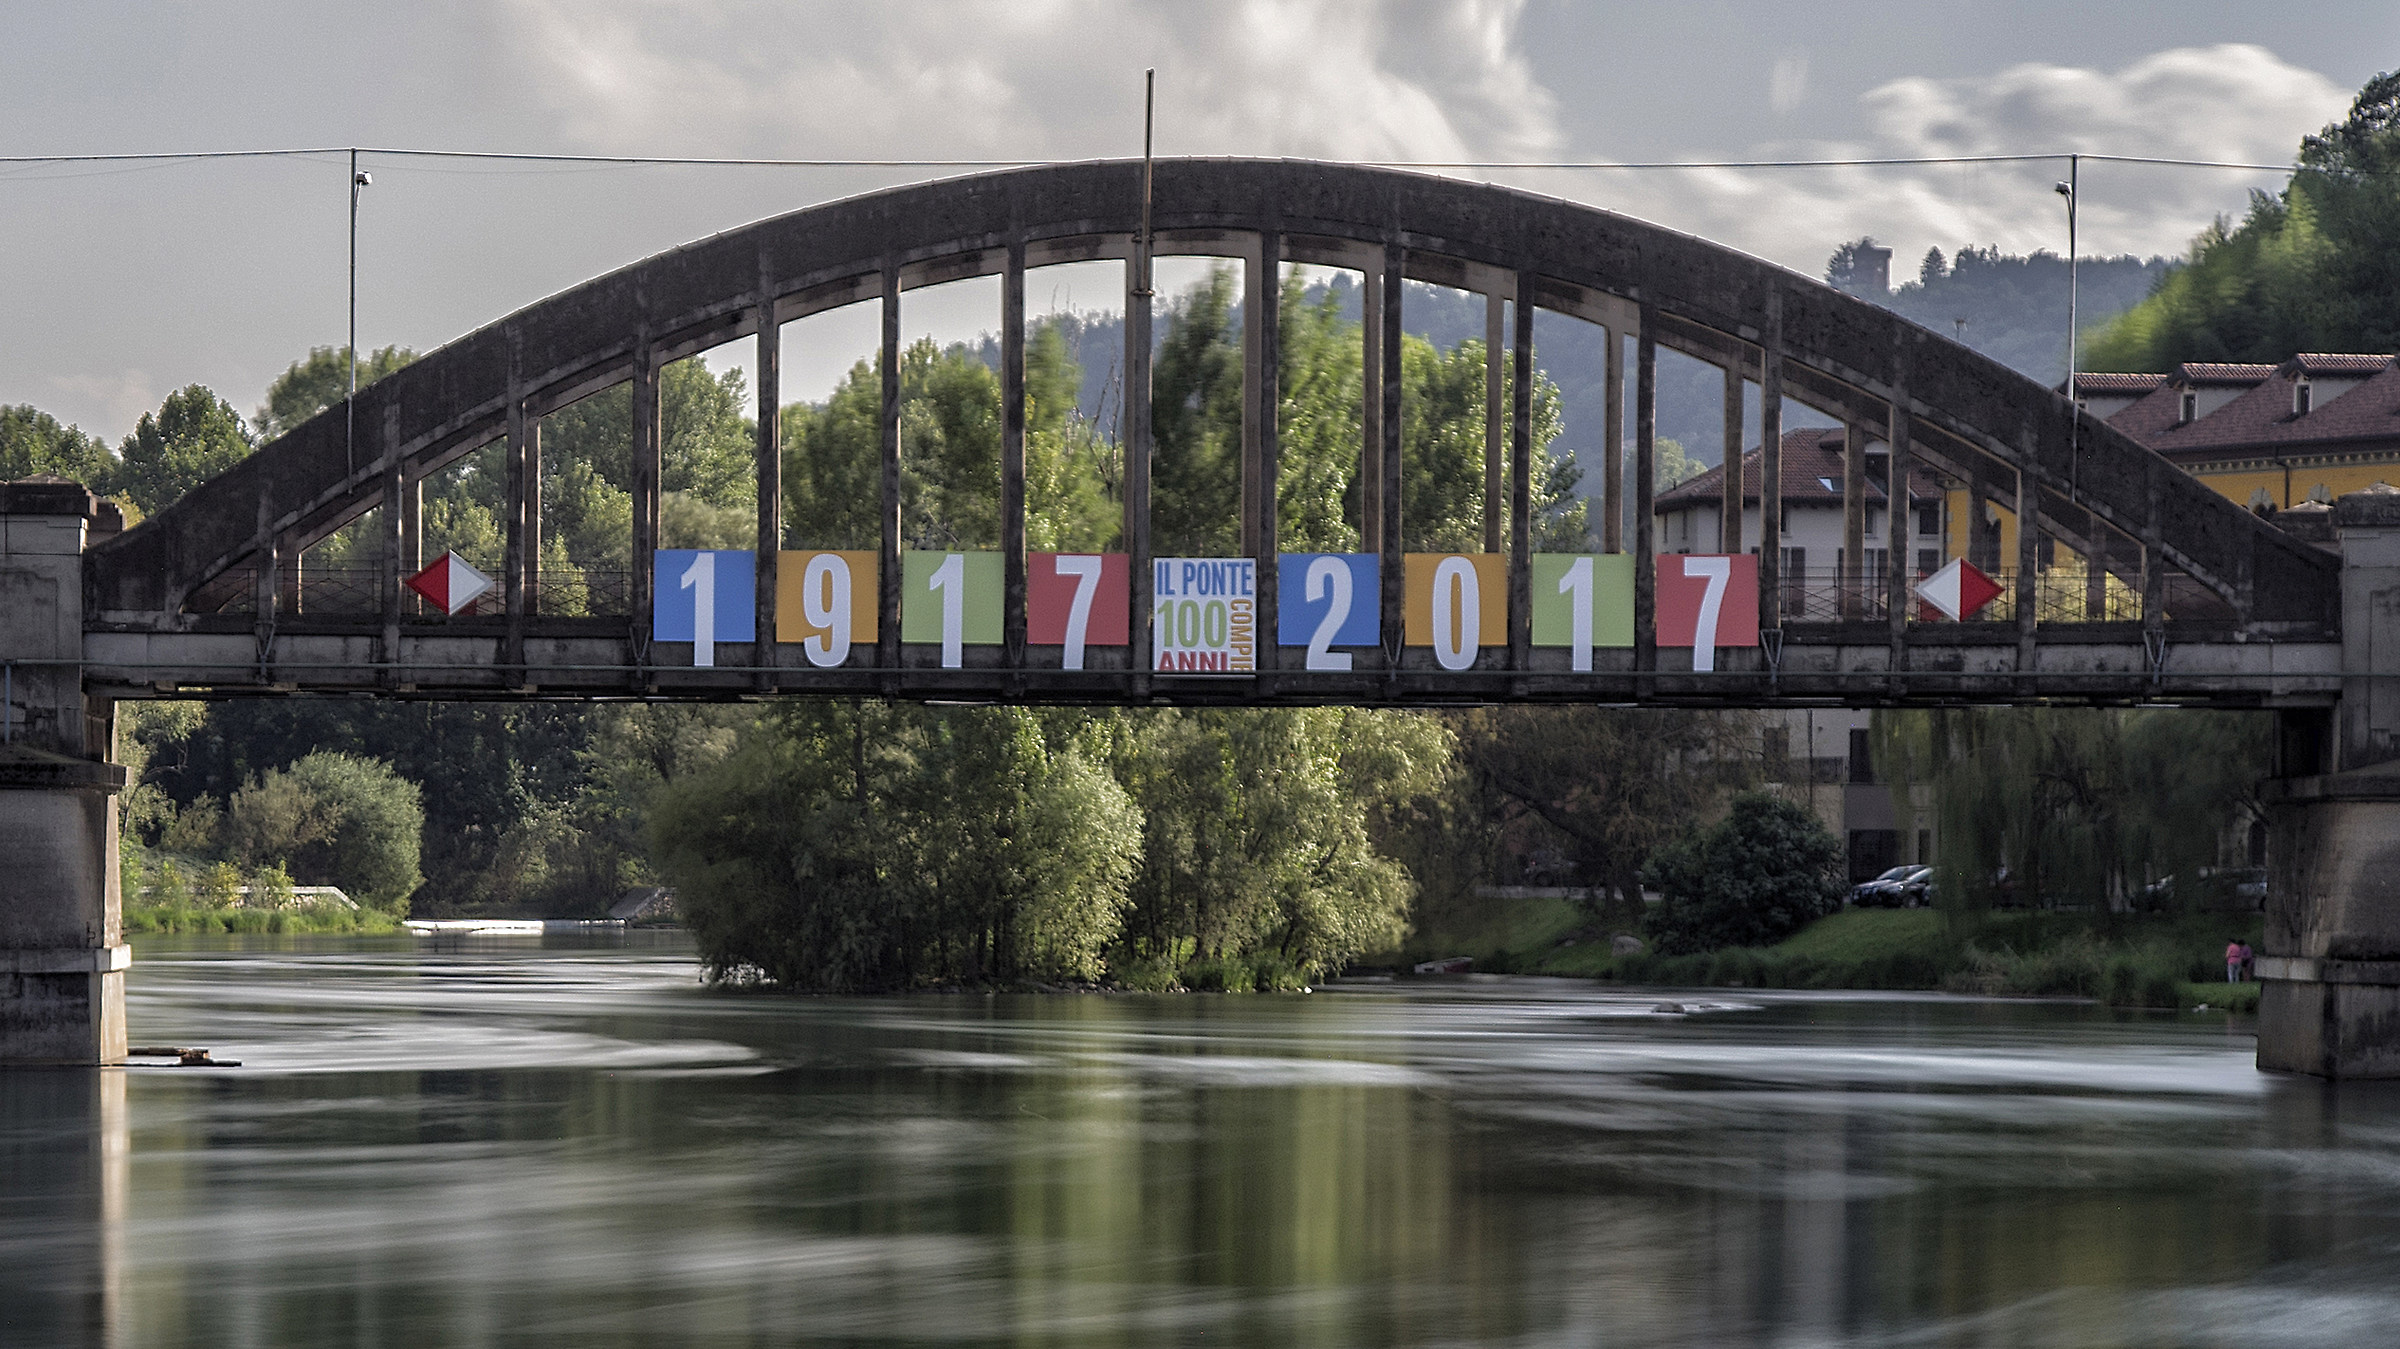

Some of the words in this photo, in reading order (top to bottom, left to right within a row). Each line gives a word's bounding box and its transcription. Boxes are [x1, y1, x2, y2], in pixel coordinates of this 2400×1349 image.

[1157, 561, 1175, 595] IL
[1182, 561, 1253, 595] PONTE
[1157, 599, 1227, 648] 100
[1230, 599, 1253, 671] COMPIE
[1158, 651, 1228, 671] ANNI
